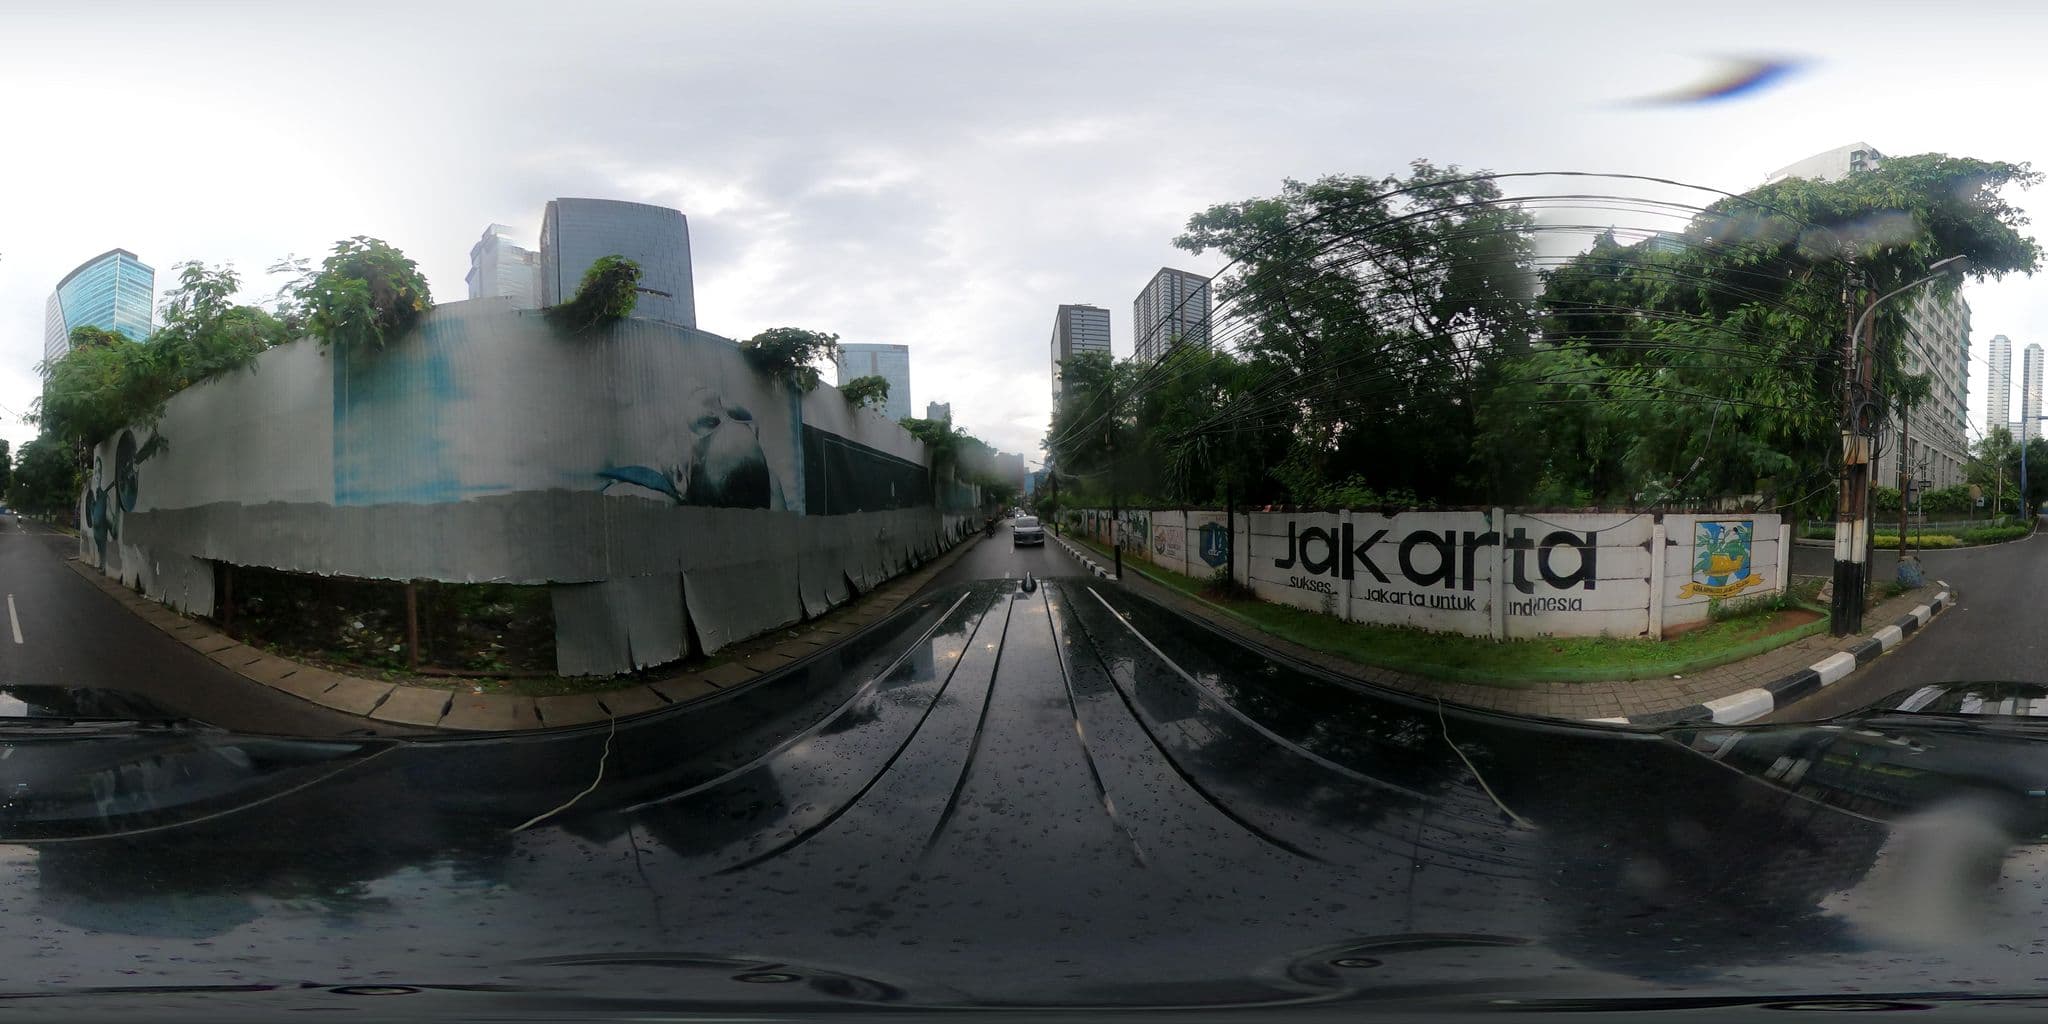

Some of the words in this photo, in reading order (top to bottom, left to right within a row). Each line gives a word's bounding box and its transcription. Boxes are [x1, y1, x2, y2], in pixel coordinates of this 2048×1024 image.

[1275, 521, 1597, 594] Jakarta
[1290, 576, 1332, 594] sukses
[1430, 594, 1476, 611] untuk
